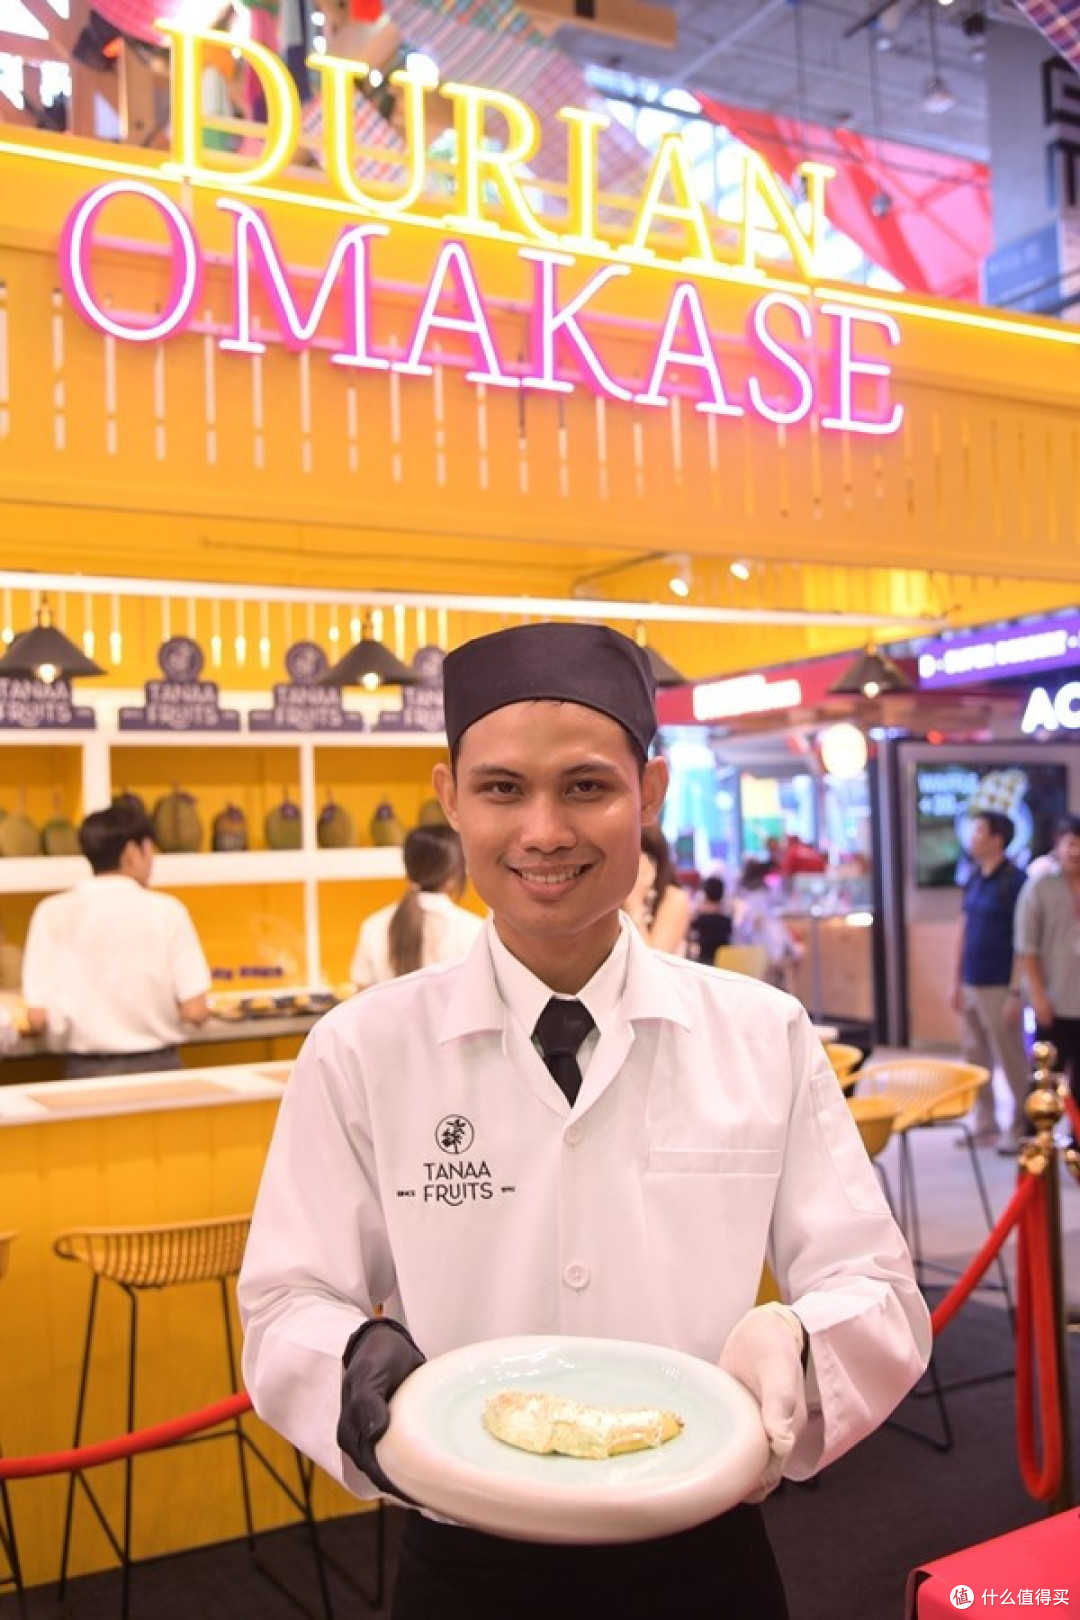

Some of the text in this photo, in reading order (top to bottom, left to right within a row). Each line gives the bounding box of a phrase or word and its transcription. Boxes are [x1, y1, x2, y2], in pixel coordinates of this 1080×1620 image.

[155, 18, 836, 278] DURIAN
[64, 180, 905, 435] OMAKASE
[148, 681, 217, 703] TANAA
[146, 702, 219, 729] FRUITS
[423, 1161, 491, 1181] TANAA
[424, 1182, 493, 1206] FRUITS
